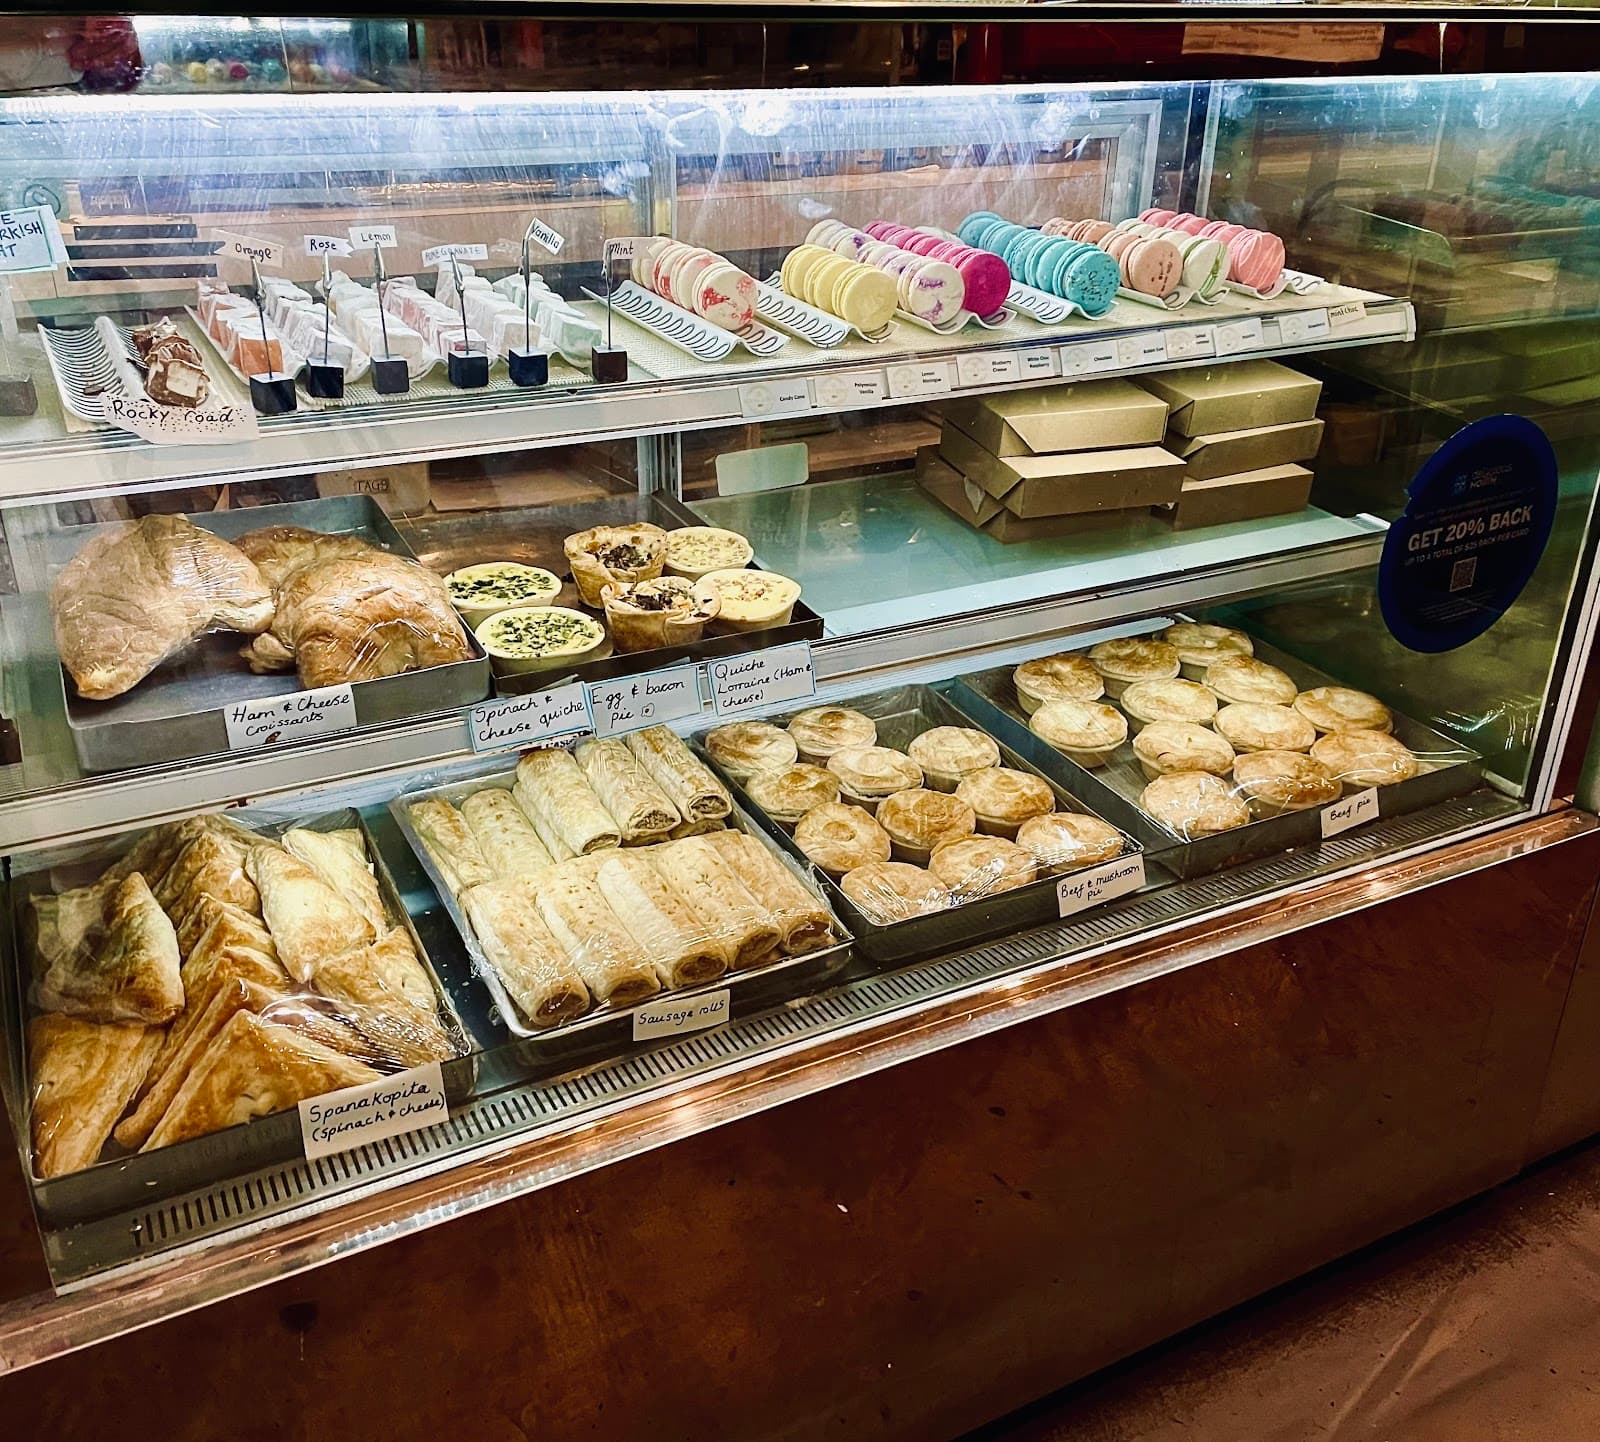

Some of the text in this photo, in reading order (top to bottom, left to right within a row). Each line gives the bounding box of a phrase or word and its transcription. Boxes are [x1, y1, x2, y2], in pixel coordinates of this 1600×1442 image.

[310, 239, 336, 251] Rose
[361, 232, 391, 242] Lemon
[609, 241, 634, 255] Mint
[235, 243, 271, 262] Orange
[113, 400, 233, 423] Rocky road
[1407, 504, 1534, 551] GET 20% BACK
[715, 659, 765, 681] Quiche
[592, 686, 624, 710] Egg
[646, 679, 686, 695] bacon
[718, 677, 770, 694] Lorraine
[232, 705, 276, 723] Ham
[298, 694, 350, 711] Cheese
[475, 697, 538, 726] Spinach
[540, 701, 585, 728] quiche
[611, 707, 634, 728] pie
[1330, 796, 1371, 820] Beef pie
[1061, 884, 1084, 898] Beef
[1096, 865, 1140, 886] mushroom
[1087, 887, 1102, 901] pie
[639, 1000, 724, 1025] Sausage rolls
[312, 1111, 385, 1142] (spinach
[400, 1091, 446, 1117] cheese)
